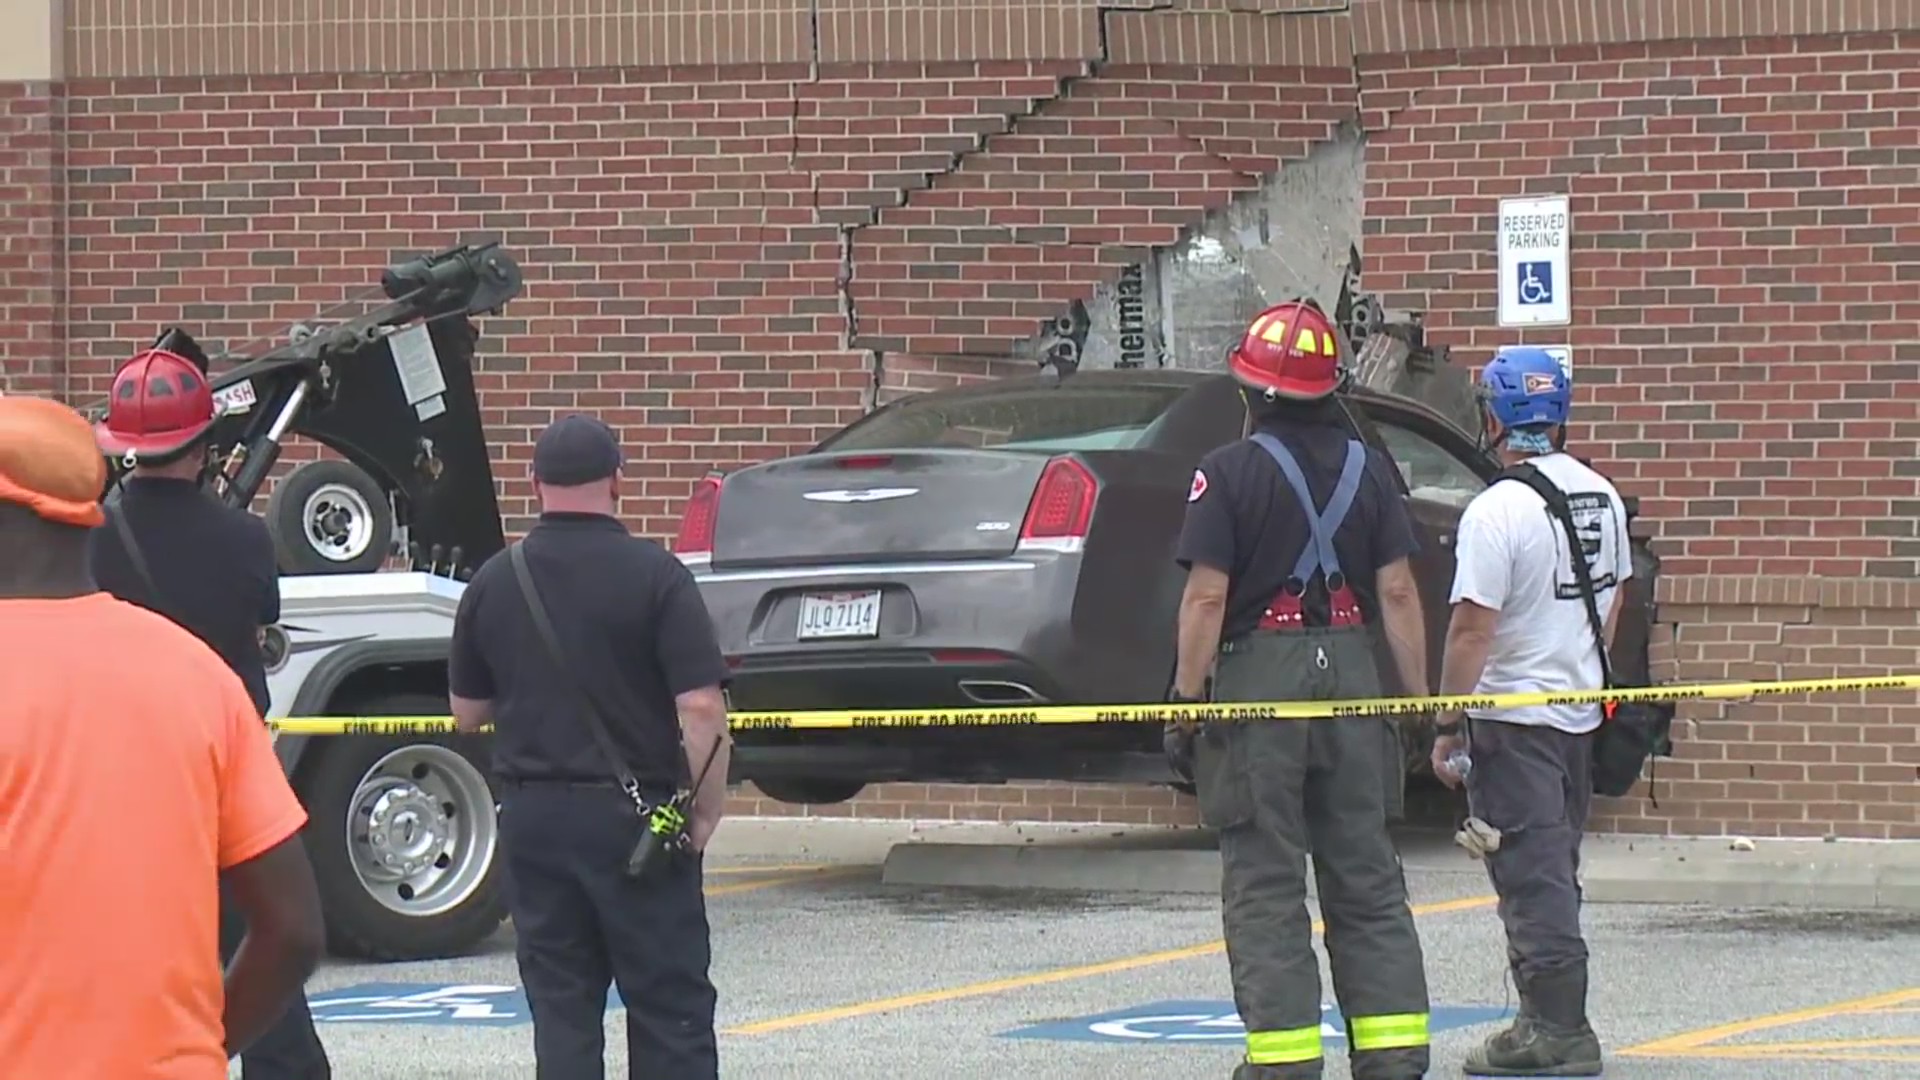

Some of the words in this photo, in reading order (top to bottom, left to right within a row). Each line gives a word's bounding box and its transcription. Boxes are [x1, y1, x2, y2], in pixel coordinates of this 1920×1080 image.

[1504, 213, 1565, 232] RESERVED
[1508, 231, 1560, 249] PARKING
[837, 603, 873, 629] 7114
